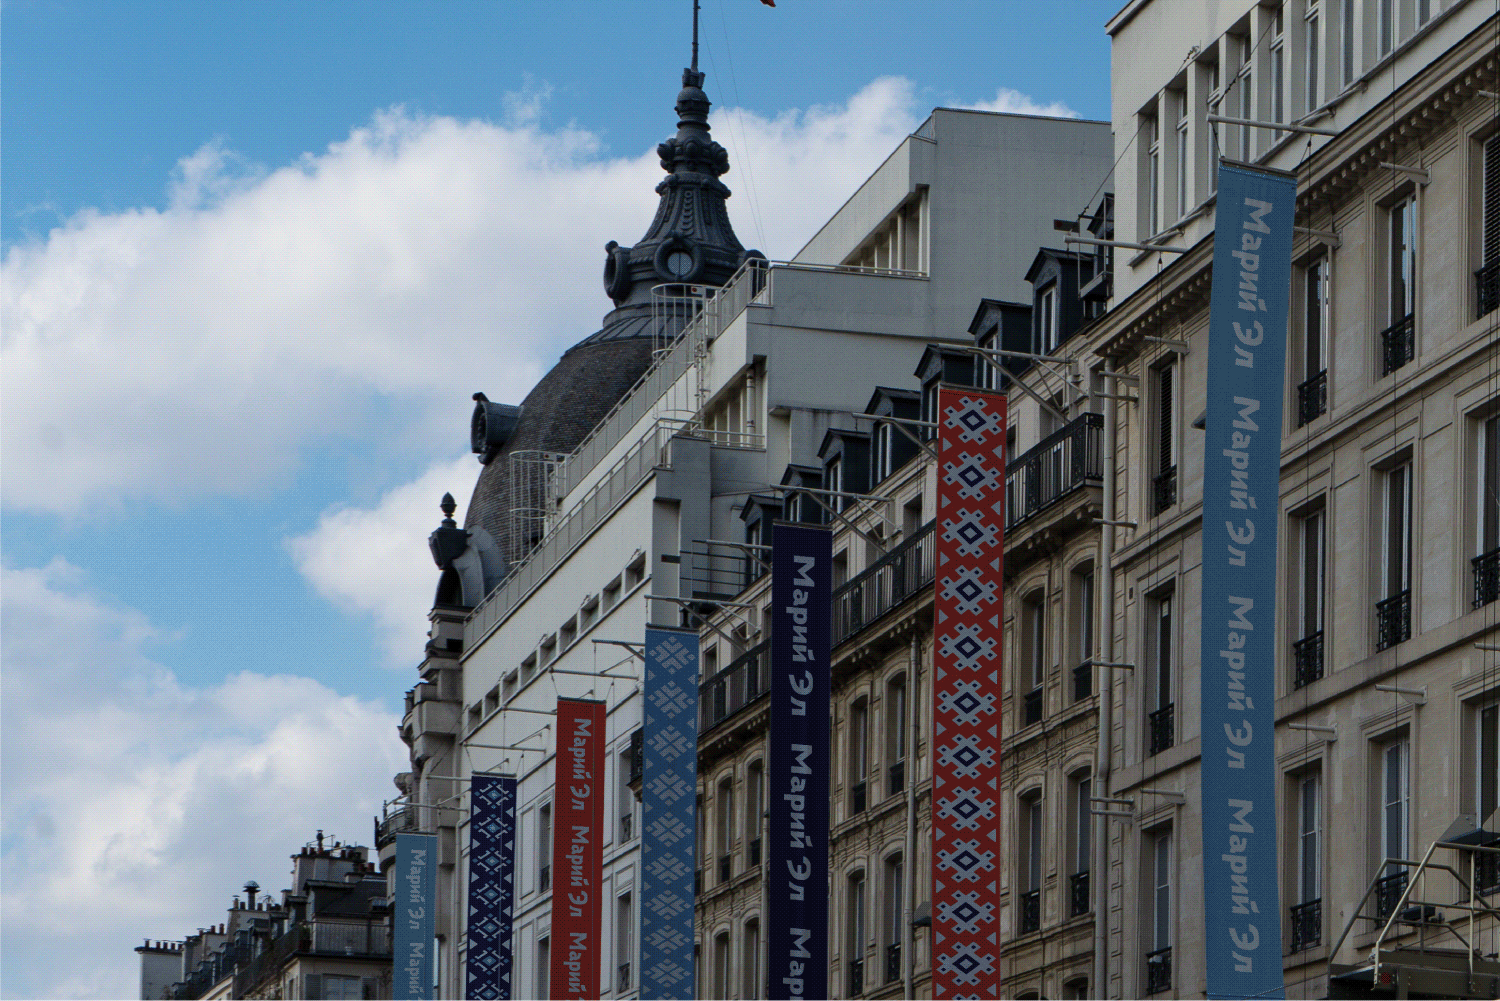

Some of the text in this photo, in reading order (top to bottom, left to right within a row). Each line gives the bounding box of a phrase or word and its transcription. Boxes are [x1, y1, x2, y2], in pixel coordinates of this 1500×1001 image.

[1220, 198, 1272, 972] Марий Эл Марий Эл Марий Эл Марий Эл
[405, 850, 426, 993] Марий Эл Марий
[564, 719, 591, 992] Марий Эл Марий Эл Марий
[783, 556, 815, 1000] Марий Эл Марий Эл Мар
